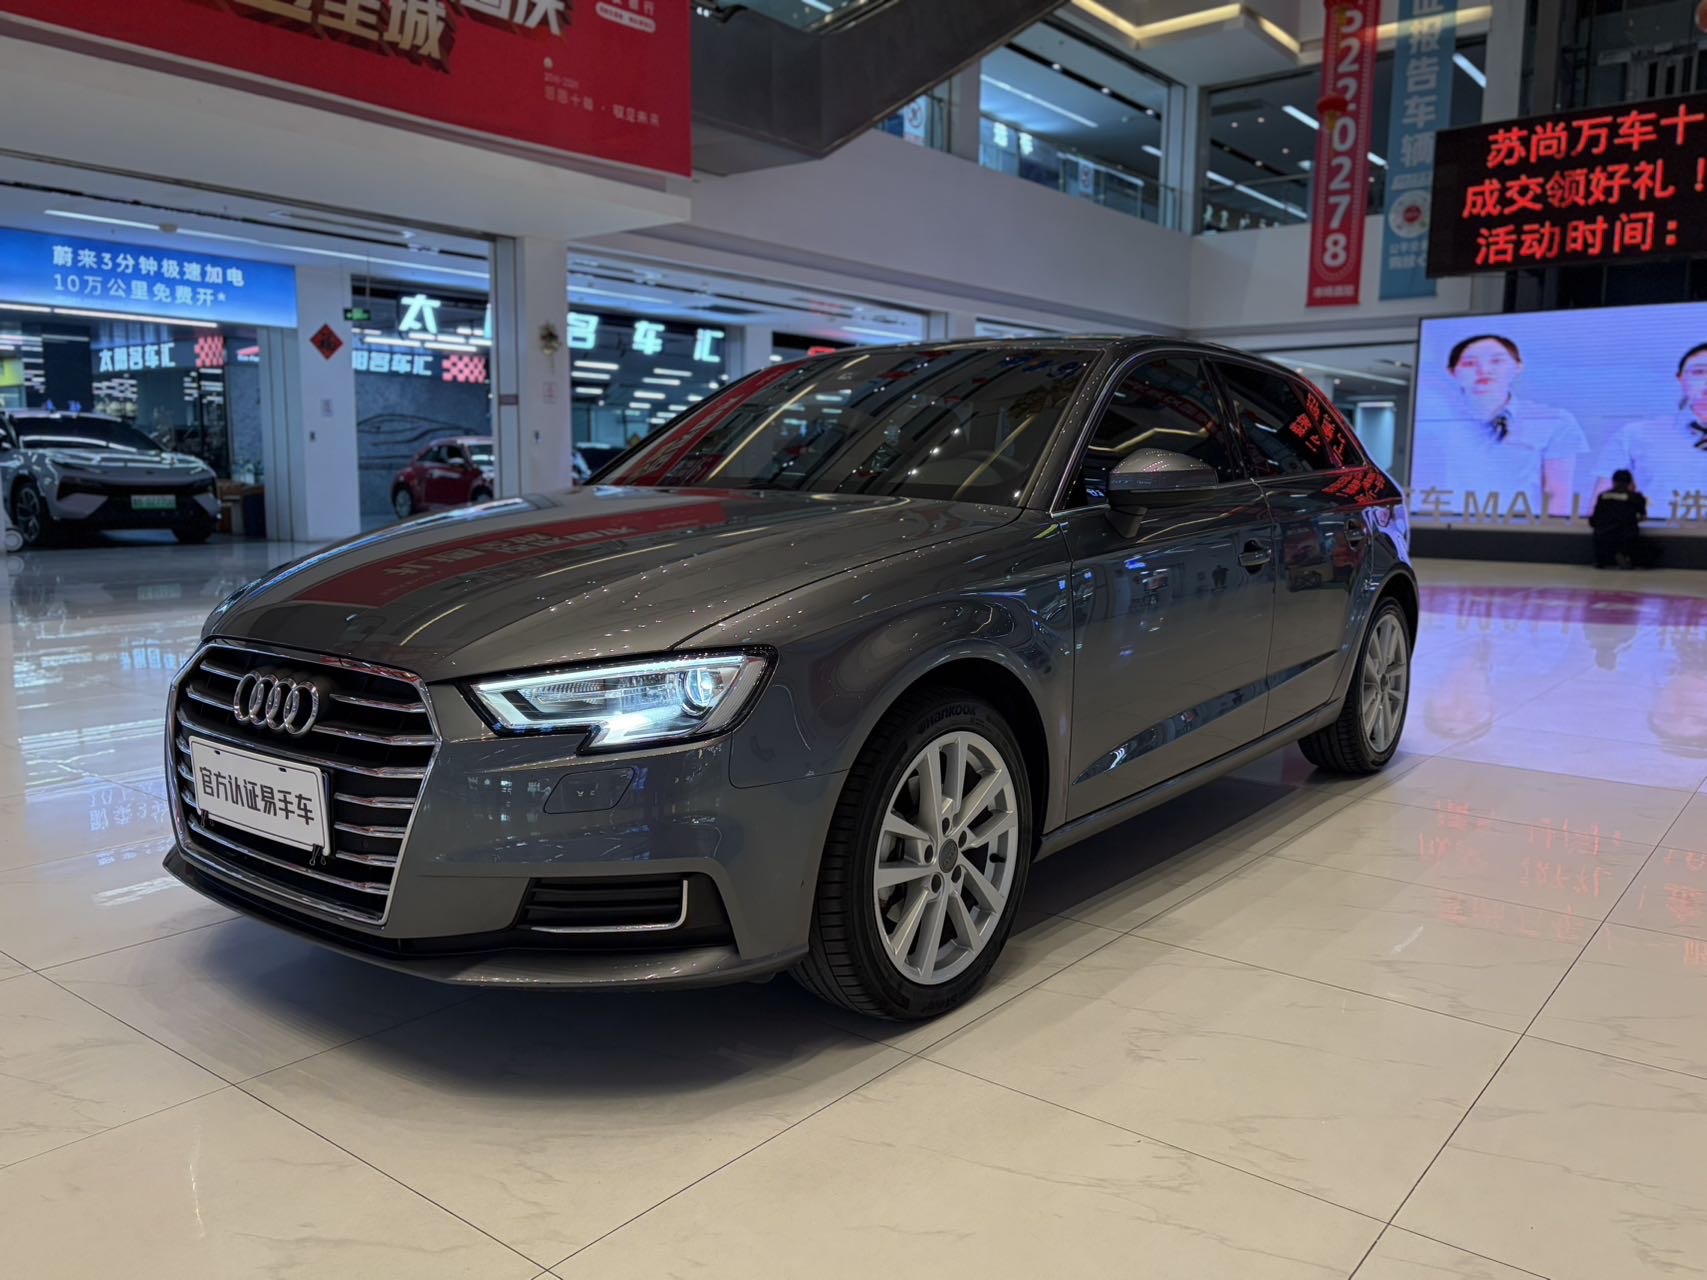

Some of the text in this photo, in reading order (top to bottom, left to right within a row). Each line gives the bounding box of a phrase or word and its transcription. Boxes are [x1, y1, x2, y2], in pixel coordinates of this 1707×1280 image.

[1486, 104, 1705, 168] 苏尚万车十
[1474, 211, 1679, 265] 活动时间：
[52, 245, 244, 287] 蔚来3分钟极速加电
